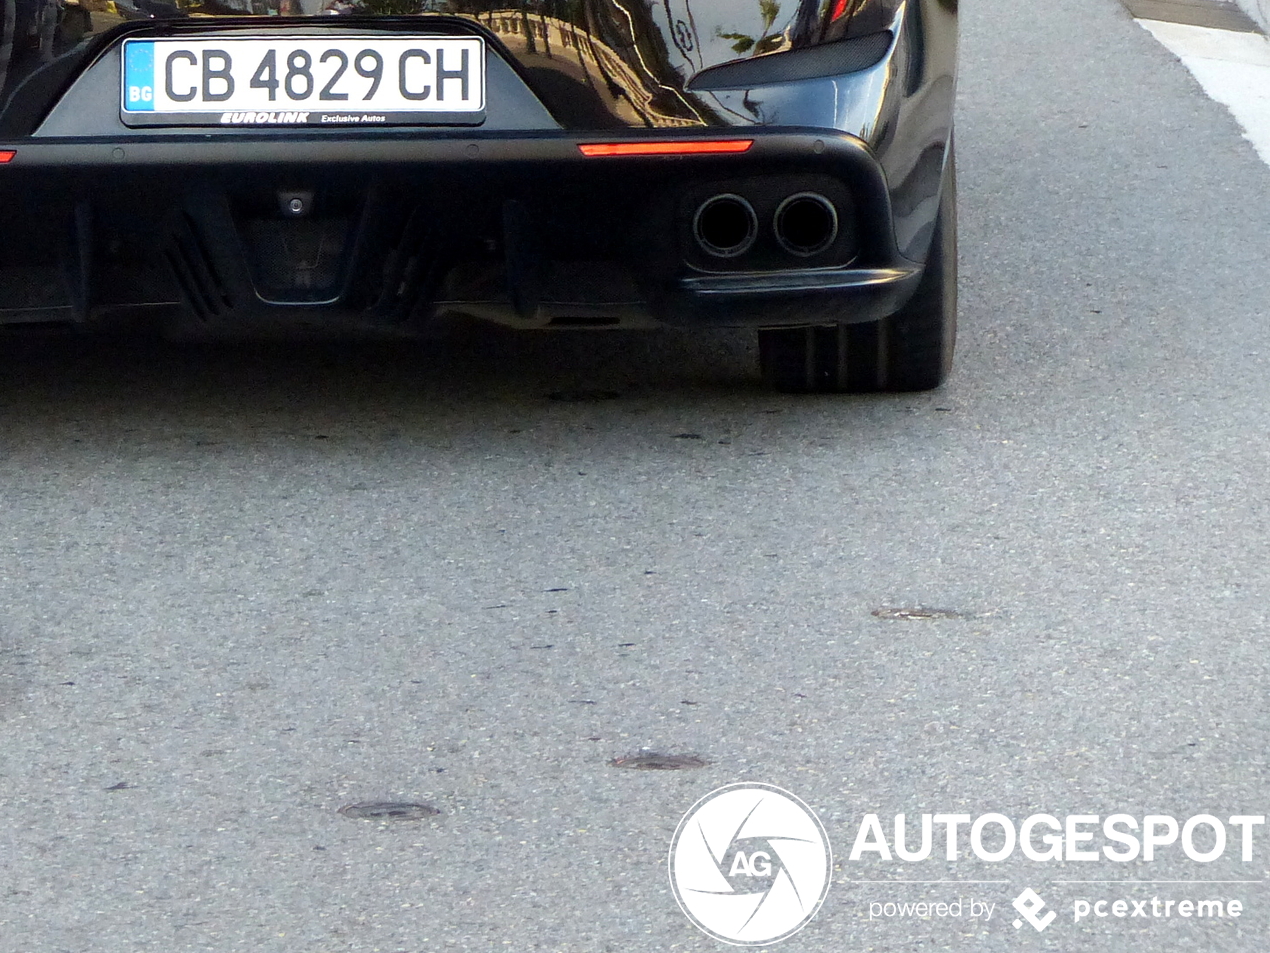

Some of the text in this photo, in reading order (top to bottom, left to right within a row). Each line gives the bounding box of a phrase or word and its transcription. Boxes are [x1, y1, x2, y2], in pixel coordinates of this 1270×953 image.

[165, 48, 470, 102] CB 4829 CH
[129, 86, 153, 102] BG
[220, 112, 386, 123] EUROLINK Exclusive Autos
